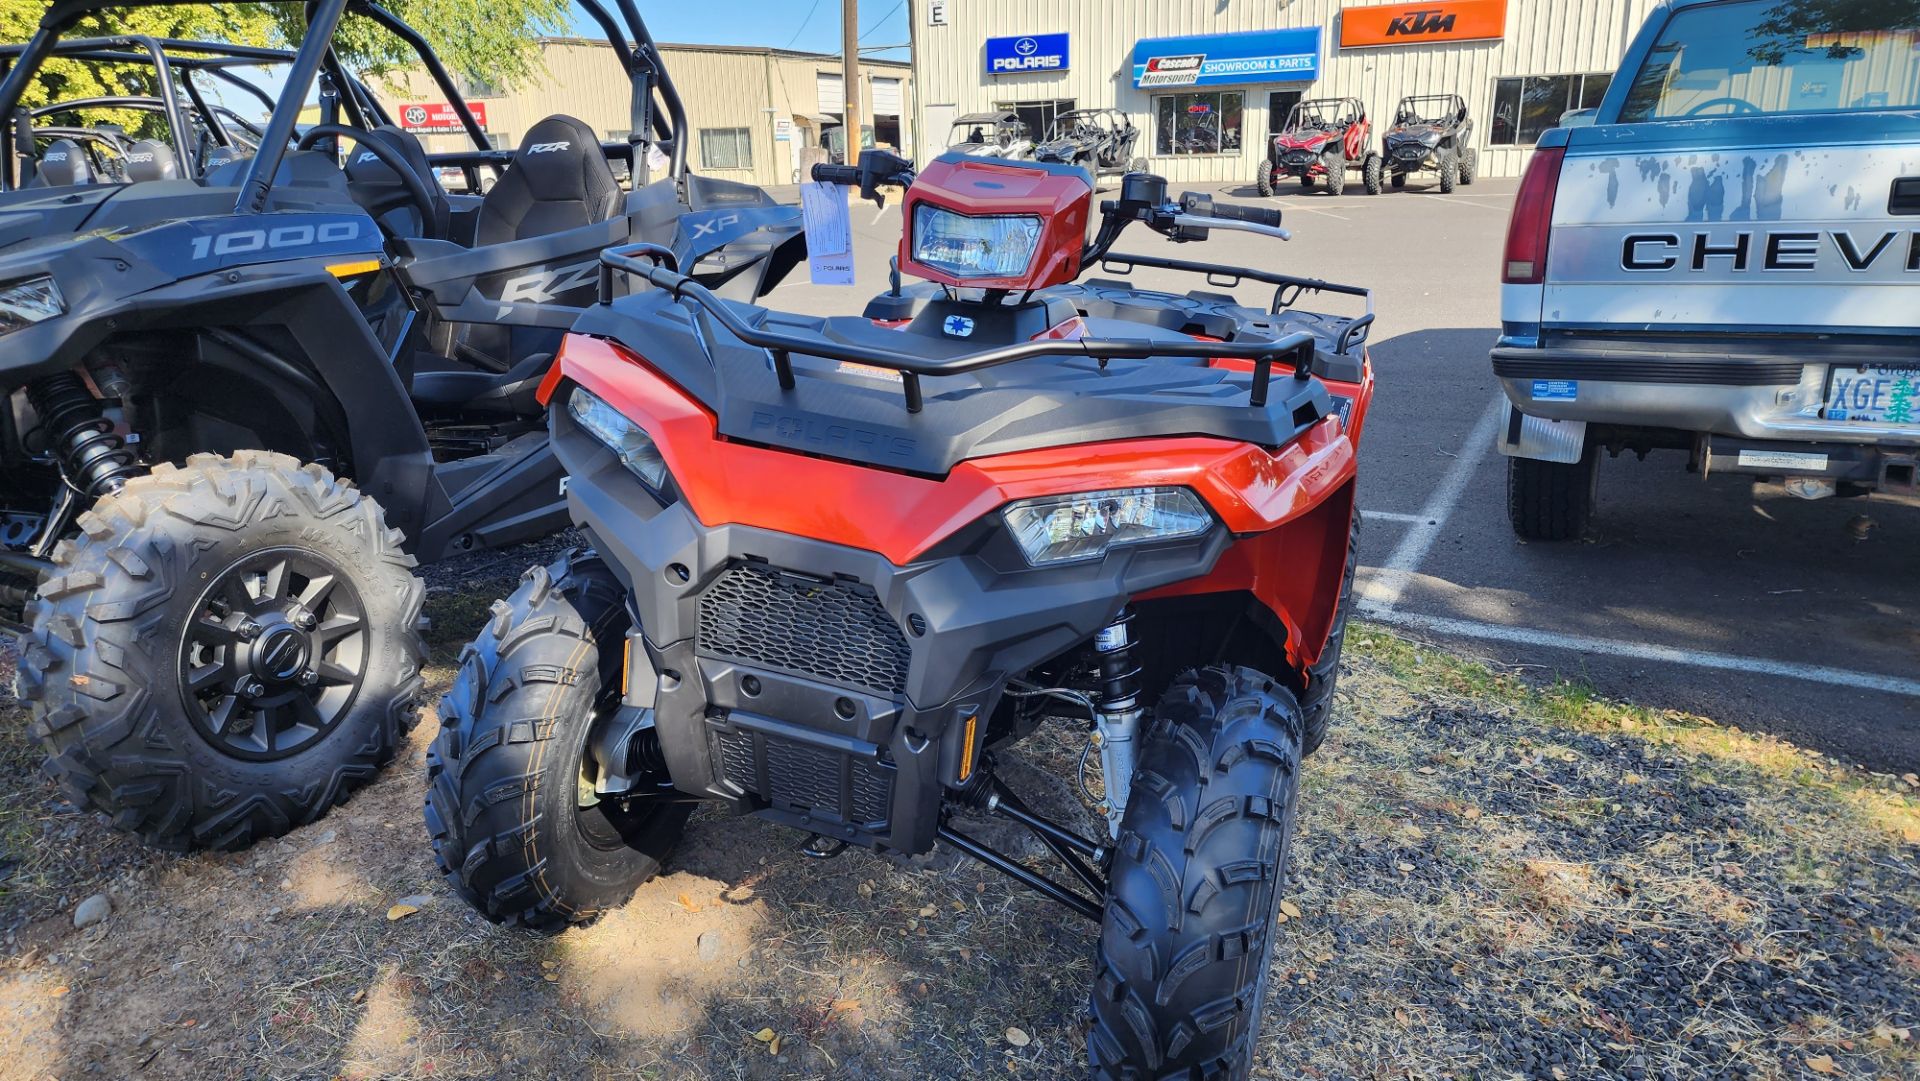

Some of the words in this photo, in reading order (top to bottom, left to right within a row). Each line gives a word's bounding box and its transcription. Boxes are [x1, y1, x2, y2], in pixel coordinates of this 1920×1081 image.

[932, 6, 943, 22] E
[1385, 9, 1457, 36] KTM
[993, 55, 1061, 70] POLARIS
[1157, 56, 1200, 71] Cascade
[1204, 59, 1268, 73] SHOWROOM
[1269, 60, 1277, 70] &
[1279, 56, 1312, 69] PARTS
[1141, 71, 1197, 85] Motorsports
[525, 141, 571, 156] RZR
[691, 214, 738, 240] XP
[191, 221, 360, 260] 1000
[1620, 229, 1920, 273] CHEV
[750, 409, 919, 457] POLARIS
